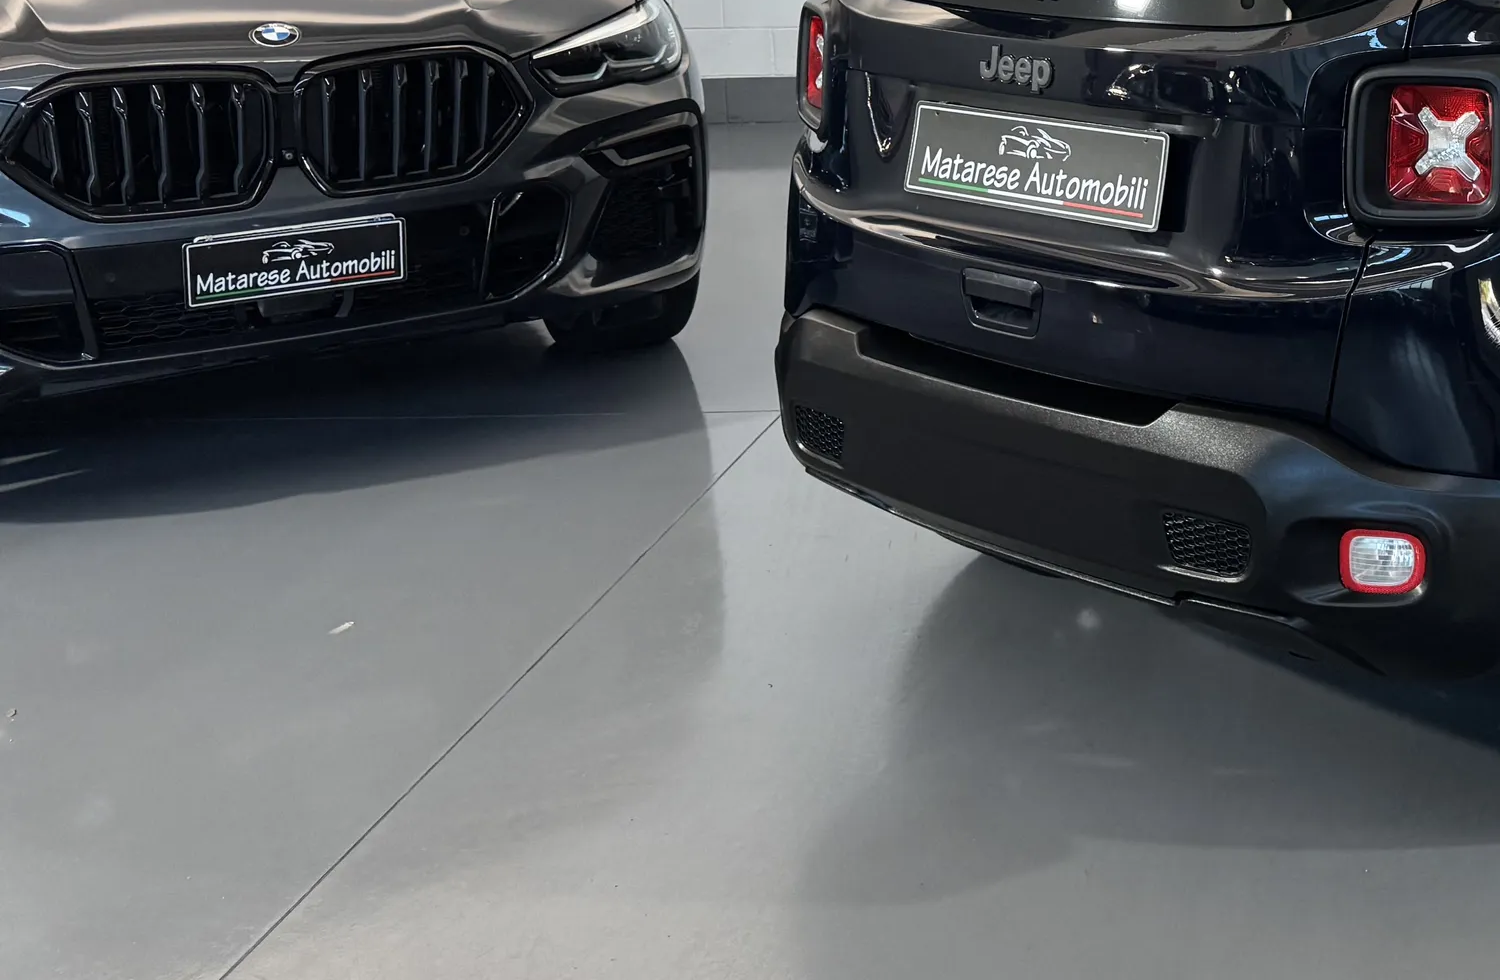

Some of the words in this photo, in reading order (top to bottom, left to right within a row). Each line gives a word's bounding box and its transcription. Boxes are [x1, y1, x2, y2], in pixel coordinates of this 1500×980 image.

[979, 45, 1052, 94] Jeep
[920, 145, 1021, 190] Matarese
[1023, 161, 1149, 210] Automobili
[196, 269, 291, 295] Matarese
[295, 249, 396, 281] Automobili
